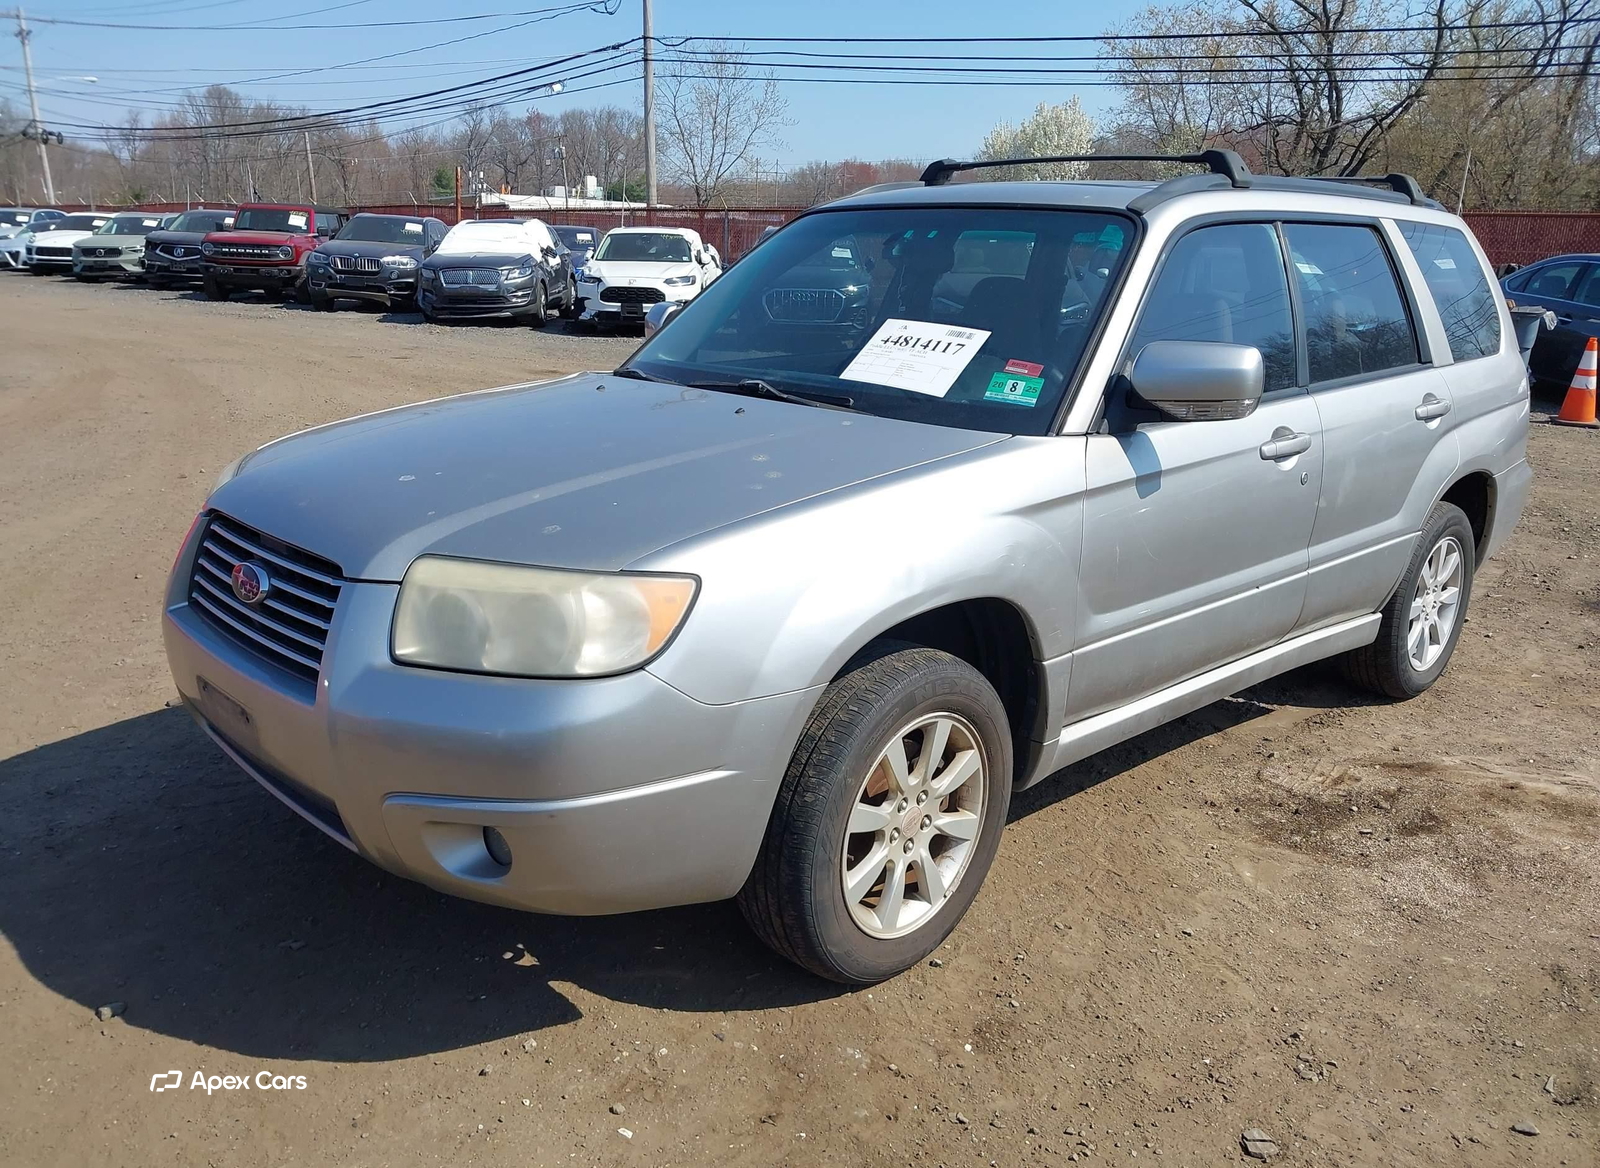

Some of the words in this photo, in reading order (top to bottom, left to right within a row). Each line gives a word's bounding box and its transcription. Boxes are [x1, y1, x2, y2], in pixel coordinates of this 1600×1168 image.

[881, 334, 966, 356] 44814117
[992, 380, 1004, 389] 20
[1009, 381, 1019, 393] 8
[1025, 385, 1038, 394] 25
